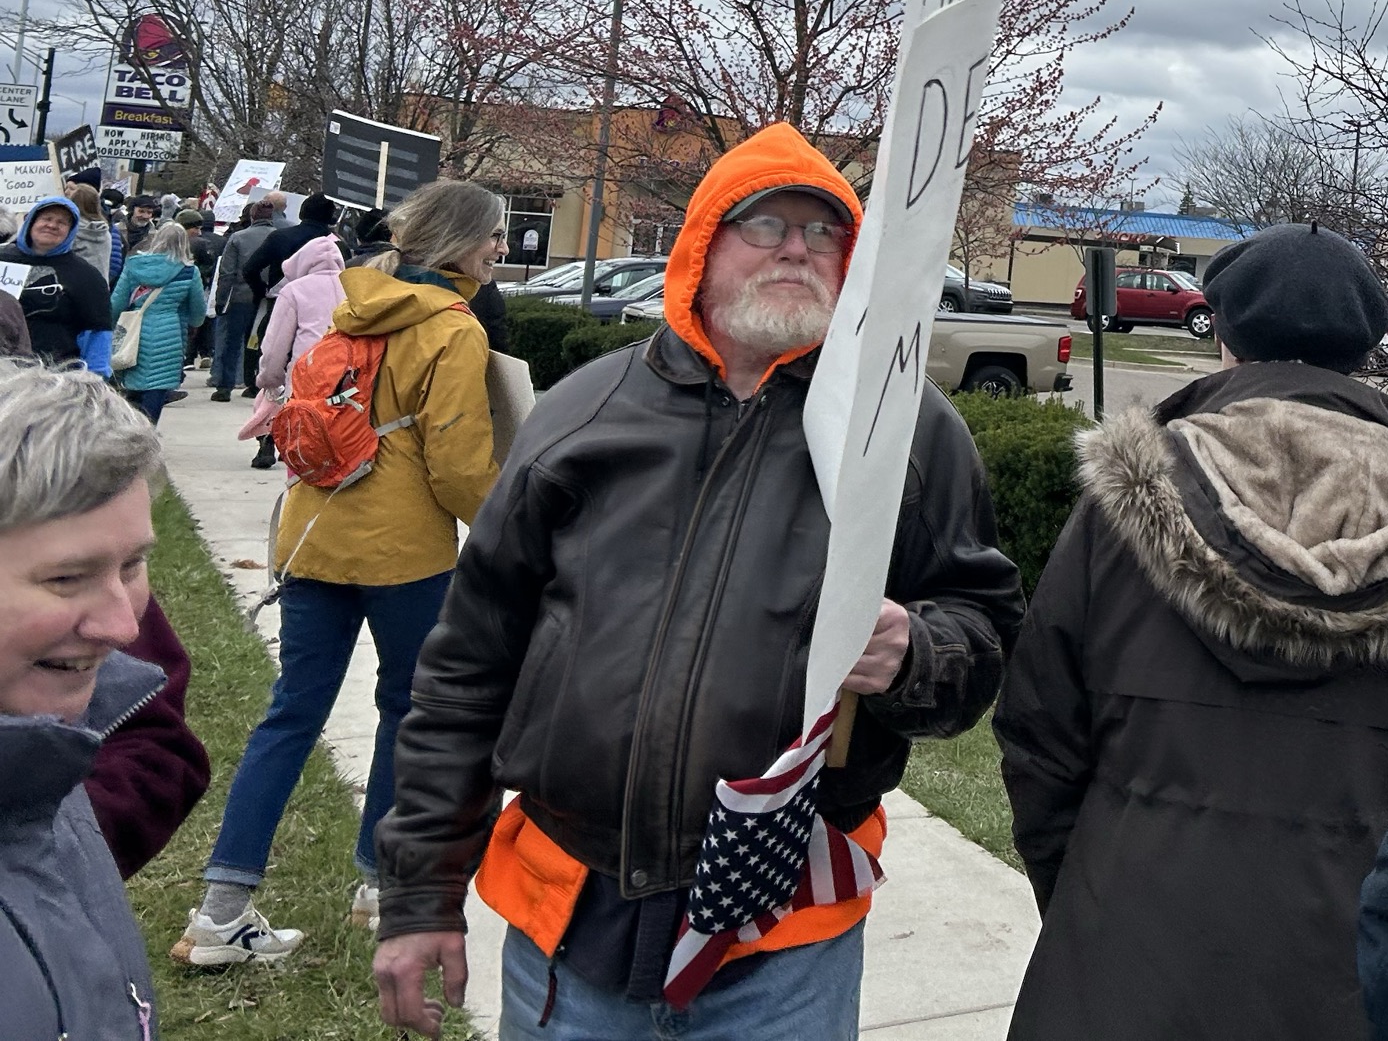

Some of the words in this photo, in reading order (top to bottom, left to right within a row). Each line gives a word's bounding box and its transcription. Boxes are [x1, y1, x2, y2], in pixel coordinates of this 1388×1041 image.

[114, 69, 187, 87] TACO
[1, 95, 26, 104] LANE
[115, 109, 173, 125] Breakfast
[104, 129, 125, 138] NOW
[108, 139, 138, 148] APPLY
[60, 133, 97, 169] FIRE
[14, 165, 53, 175] MAKING
